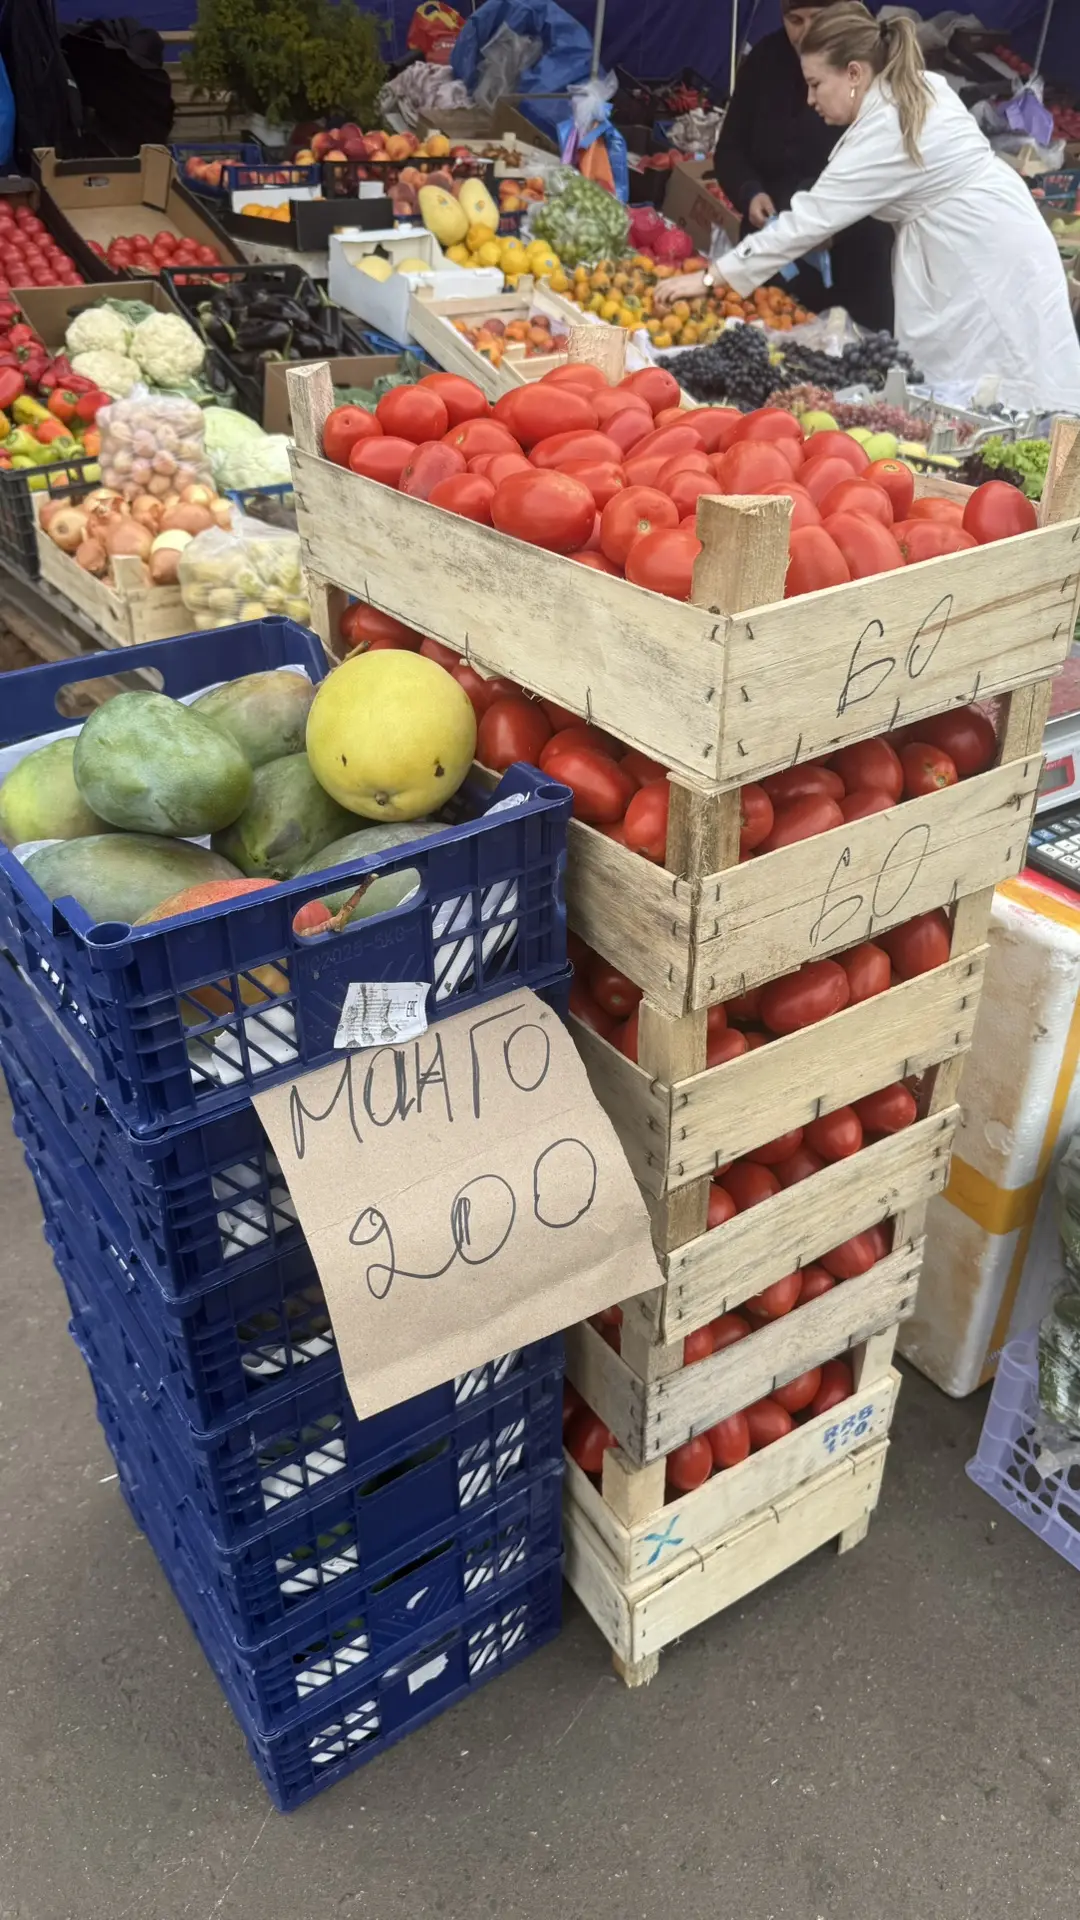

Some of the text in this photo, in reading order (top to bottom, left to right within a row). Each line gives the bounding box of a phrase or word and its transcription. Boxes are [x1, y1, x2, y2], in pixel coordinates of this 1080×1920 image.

[836, 594, 954, 718] 60
[810, 823, 932, 947] 60
[349, 1138, 596, 1299] 200
